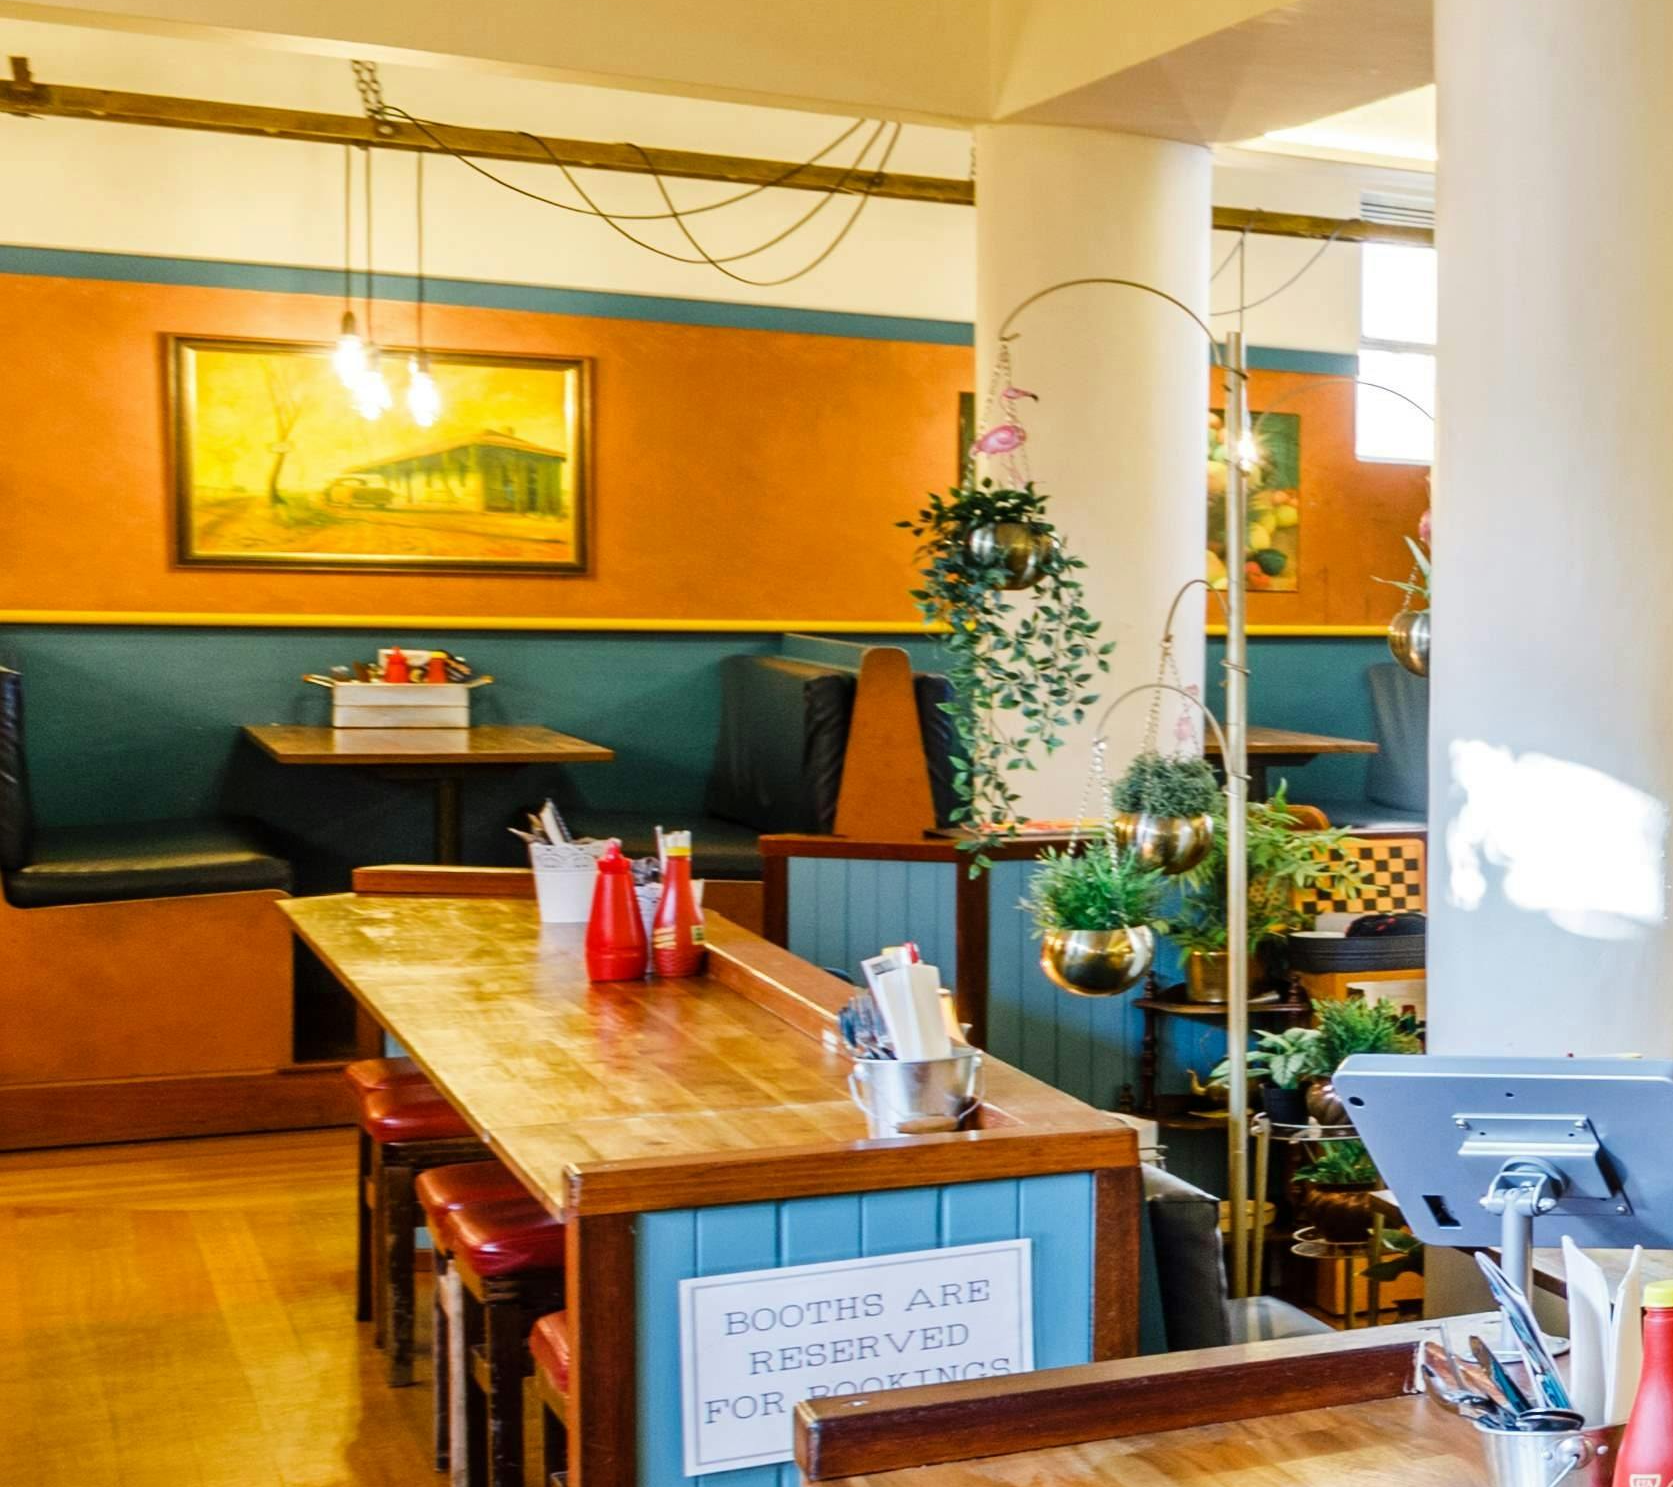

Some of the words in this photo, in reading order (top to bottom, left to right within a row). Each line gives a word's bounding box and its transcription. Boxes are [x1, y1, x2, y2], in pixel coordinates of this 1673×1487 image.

[725, 1294, 884, 1336] BOOTHS
[905, 1279, 990, 1311] ARE
[750, 1323, 970, 1375] RESERVED
[705, 1392, 785, 1424] FOR
